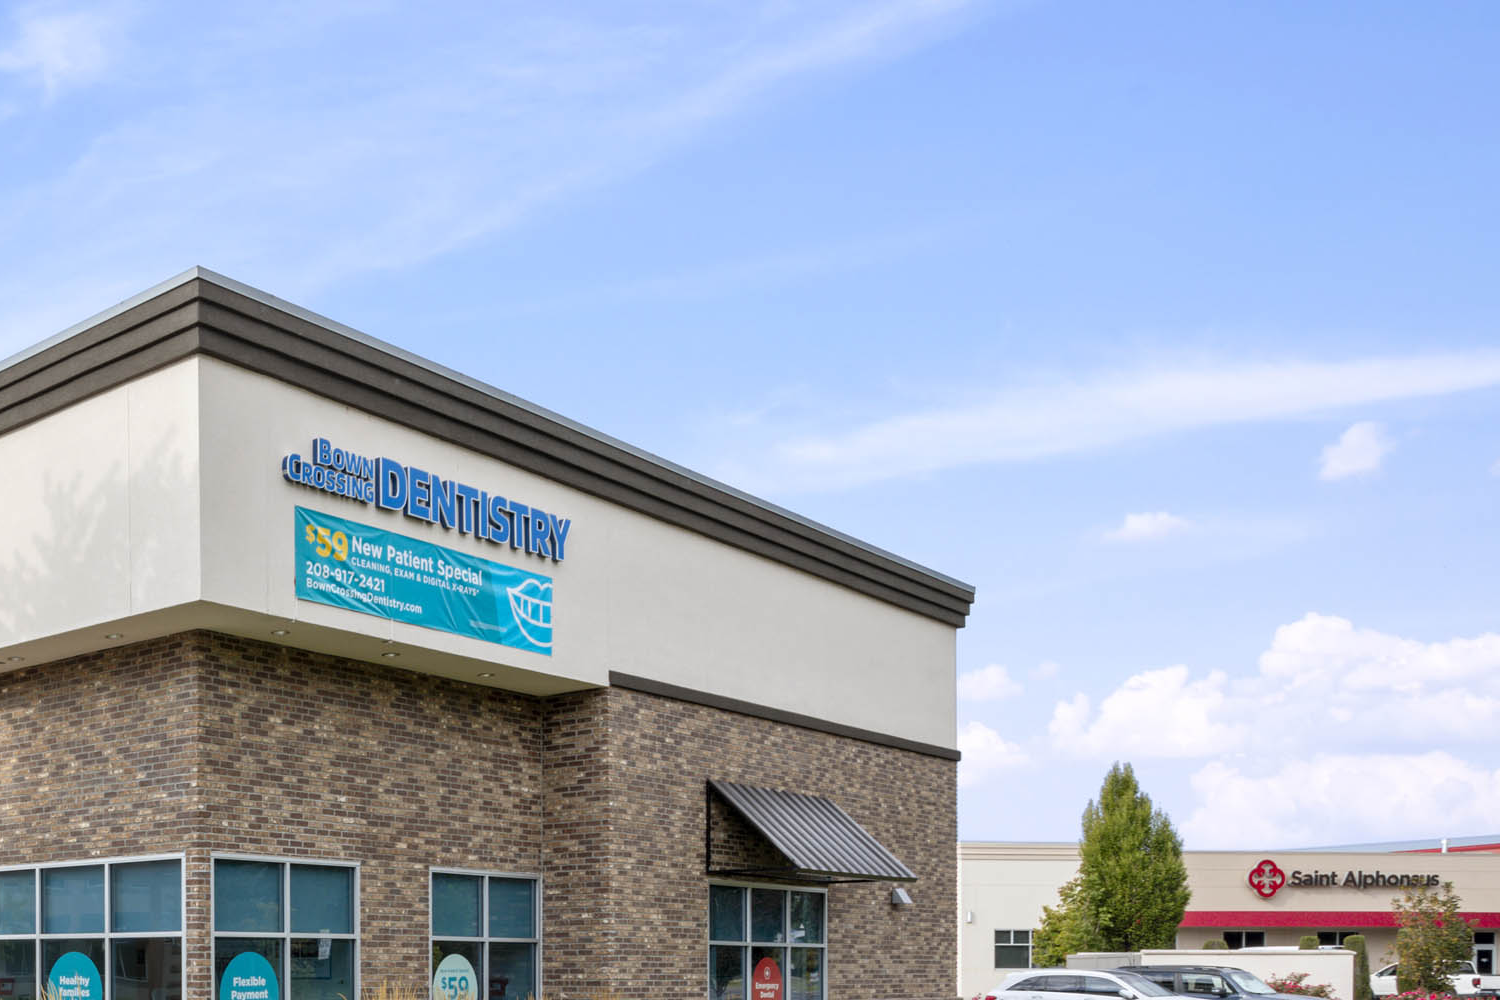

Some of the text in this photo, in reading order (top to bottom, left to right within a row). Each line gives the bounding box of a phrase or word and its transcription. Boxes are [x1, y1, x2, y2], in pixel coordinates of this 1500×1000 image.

[313, 437, 374, 480] BOWN
[283, 453, 374, 504] CROSSING
[376, 456, 571, 562] DENTISTRY
[305, 523, 483, 586] $59 New Patient Special
[305, 560, 385, 593] 208-917-2421
[350, 556, 393, 577] CLEANING,
[394, 567, 415, 580] EXAM
[416, 573, 421, 582] &
[423, 575, 451, 590] DIGITAL
[1290, 870, 1338, 887] Saint
[59, 986, 90, 997] familes
[231, 989, 268, 1000] Payment
[233, 975, 266, 987] Flexible
